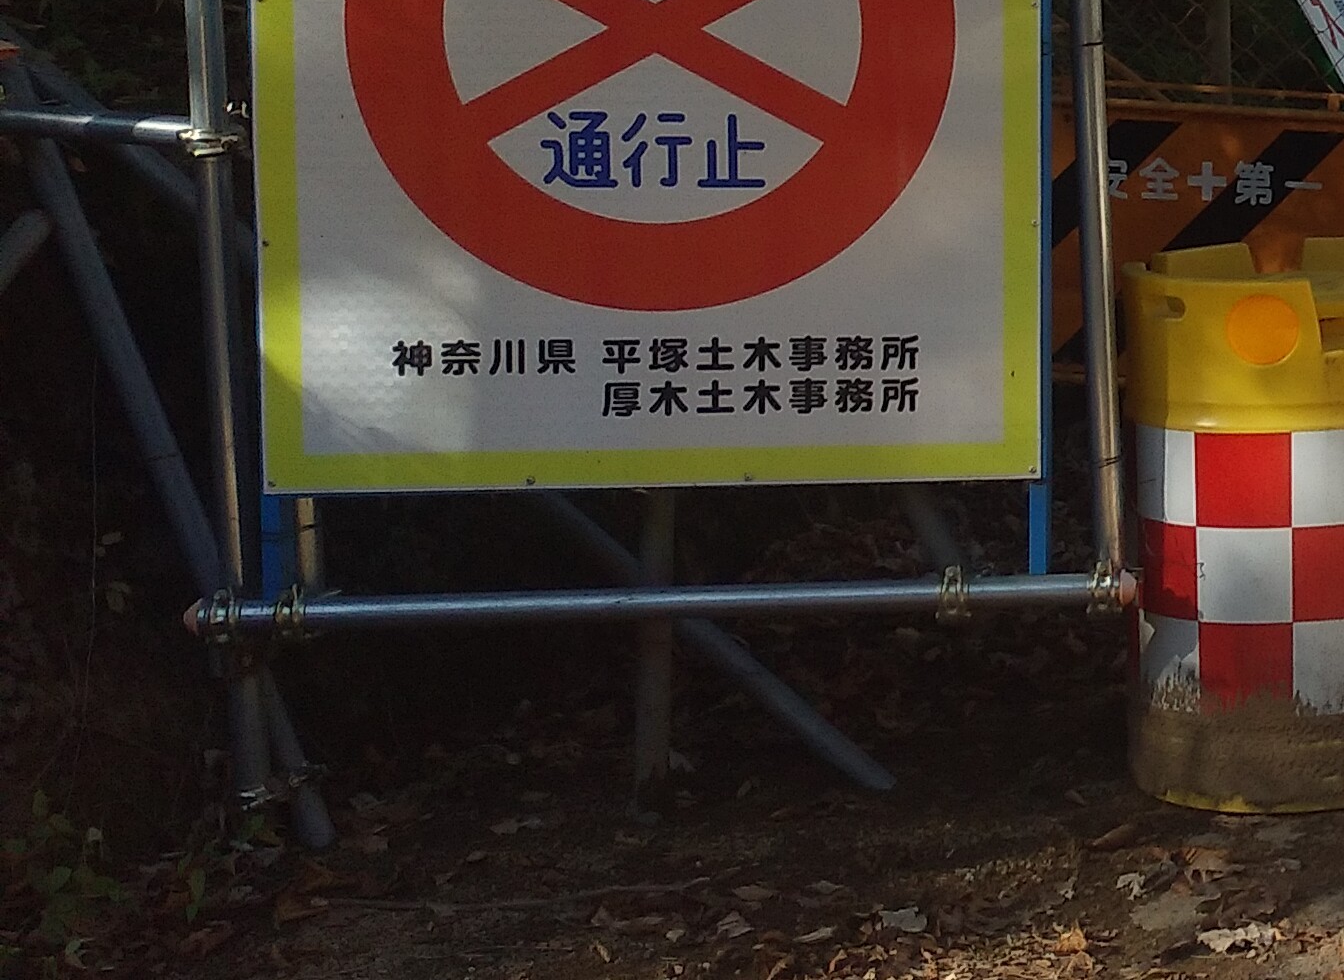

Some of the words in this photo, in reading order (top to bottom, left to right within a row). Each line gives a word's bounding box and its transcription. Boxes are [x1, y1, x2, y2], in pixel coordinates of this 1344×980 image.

[540, 111, 766, 189] 通行止
[392, 339, 576, 376] 神奈川県
[601, 335, 920, 374] 平塚土木事務所
[601, 377, 920, 416] 厚木土木事務所
